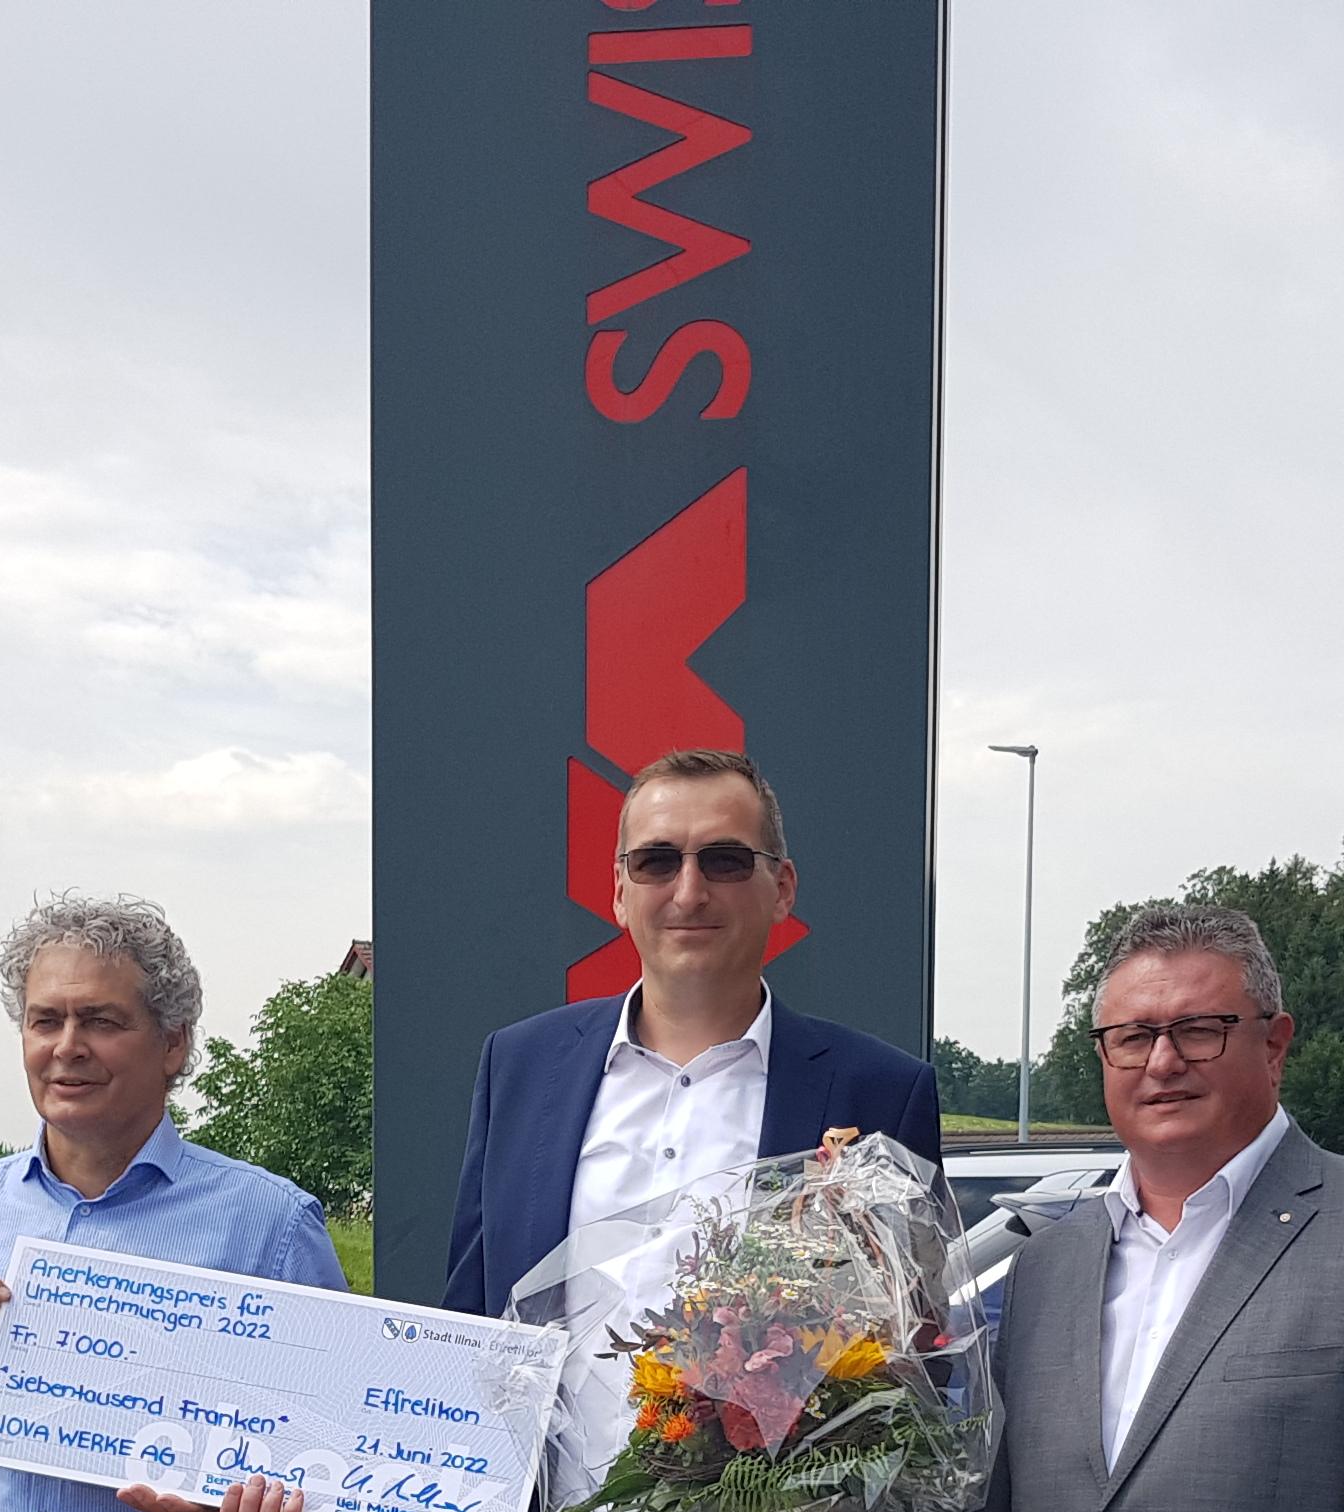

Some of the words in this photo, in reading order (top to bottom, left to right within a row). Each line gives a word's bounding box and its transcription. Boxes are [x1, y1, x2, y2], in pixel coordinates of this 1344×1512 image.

[584, 0, 752, 424] SWI
[30, 1258, 227, 1309] Anerkennungspreis
[237, 1293, 274, 1317] für
[25, 1281, 202, 1332] Unternehmungen
[218, 1317, 271, 1340] 2022
[10, 1324, 37, 1346] Fr.
[422, 1329, 452, 1344] Stadt
[58, 1426, 137, 1456] WERKE
[140, 1444, 176, 1467] AG
[354, 1435, 383, 1456] 21.
[388, 1441, 434, 1464] Juni
[441, 1452, 488, 1474] 2022
